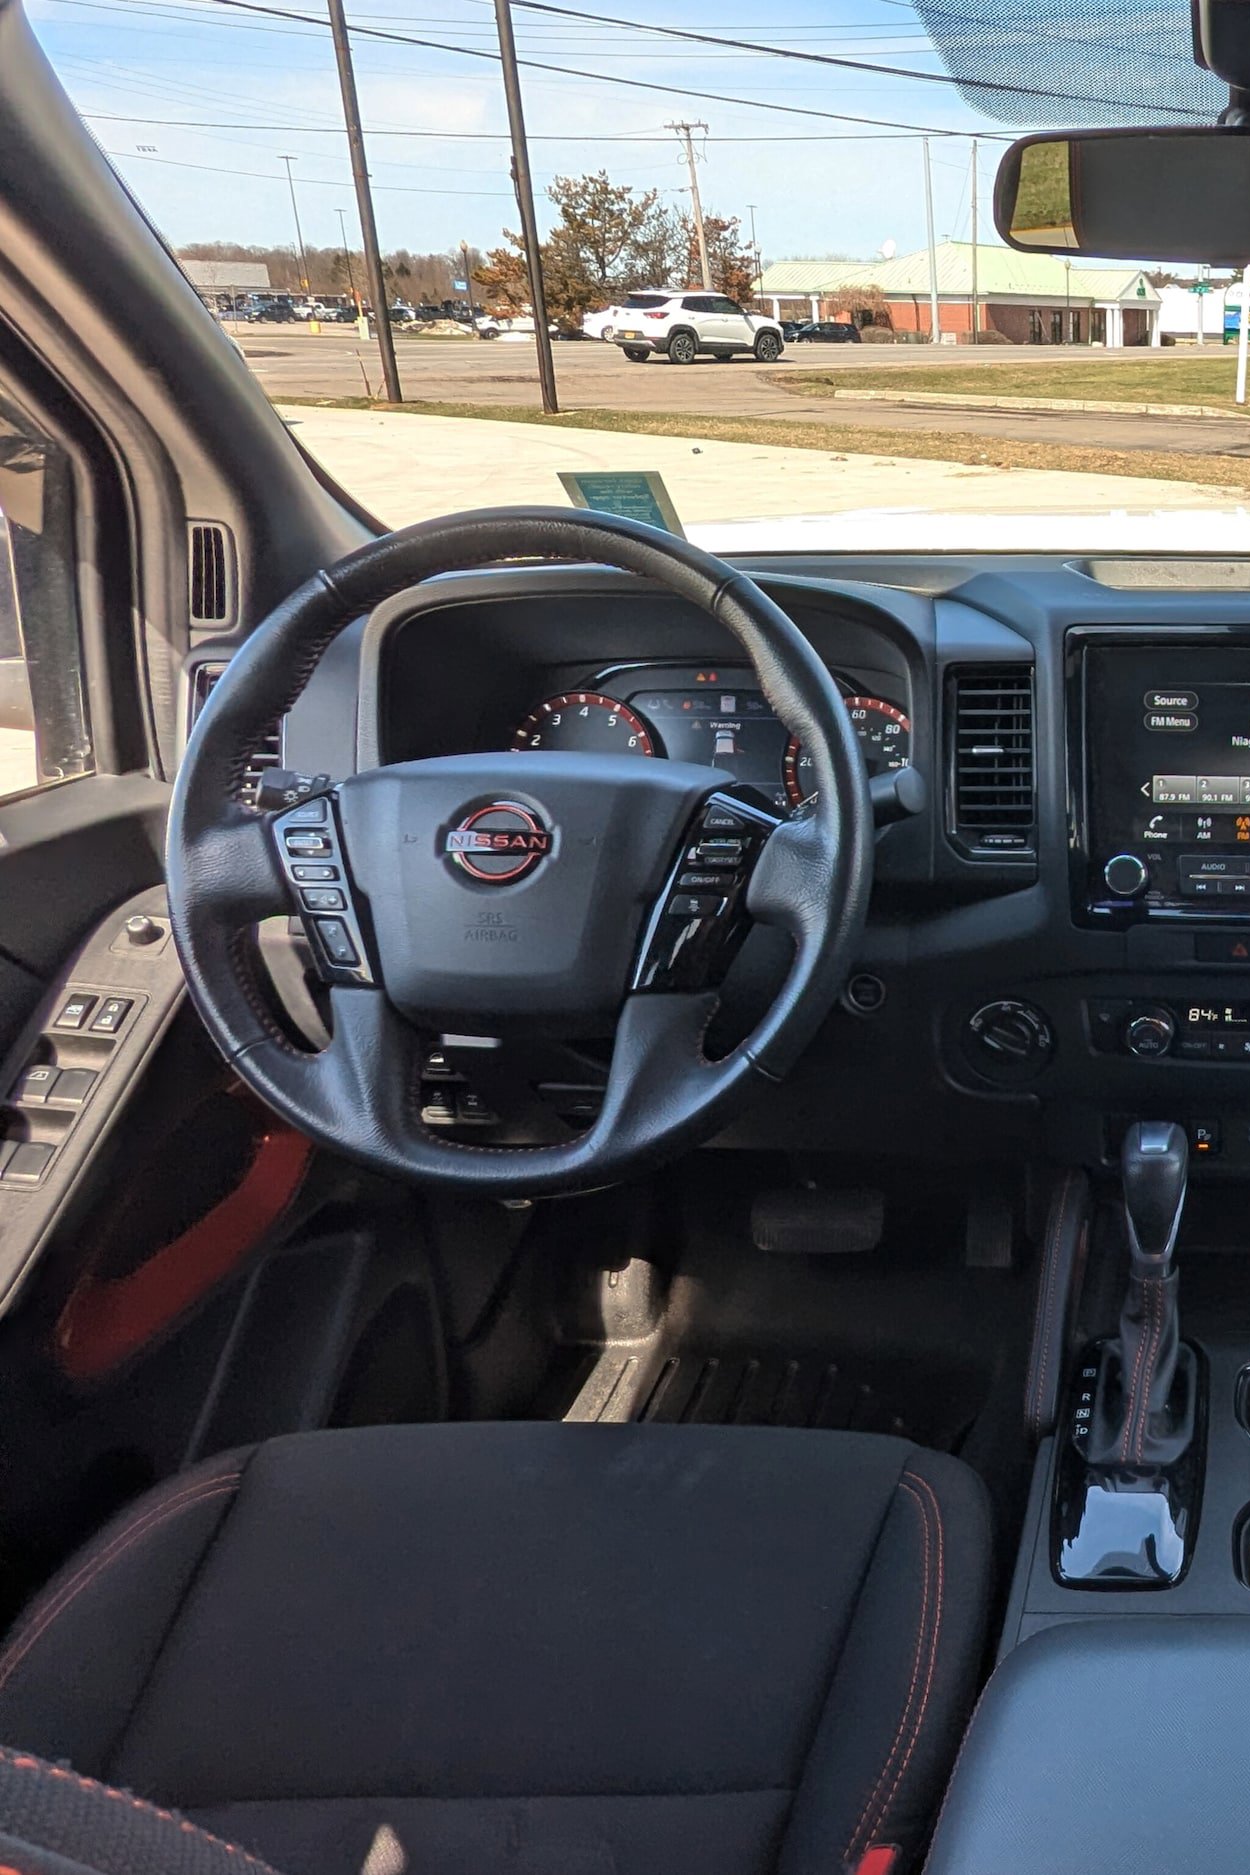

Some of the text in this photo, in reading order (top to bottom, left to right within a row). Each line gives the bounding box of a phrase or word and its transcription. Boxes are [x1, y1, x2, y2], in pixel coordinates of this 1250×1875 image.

[1153, 695, 1188, 706] Source
[579, 706, 589, 717] 4
[851, 709, 866, 719] 60
[552, 714, 561, 726] 3
[608, 715, 617, 727] 5
[1151, 717, 1190, 727] FM Menu
[709, 721, 741, 730] Warning
[885, 724, 900, 734] 80
[531, 735, 541, 746] 2
[628, 736, 637, 747] 6
[1158, 793, 1175, 801] 87.9
[1221, 794, 1234, 802] FM
[1143, 830, 1168, 839] Phone
[1197, 831, 1211, 839] AM
[1237, 831, 1250, 840] FM
[451, 833, 548, 850] NISSAN
[1201, 863, 1226, 871] AUDIO
[478, 912, 503, 925] SRS
[464, 929, 517, 943] AIRBAG
[1082, 1392, 1091, 1401] R
[1080, 1427, 1089, 1435] D
